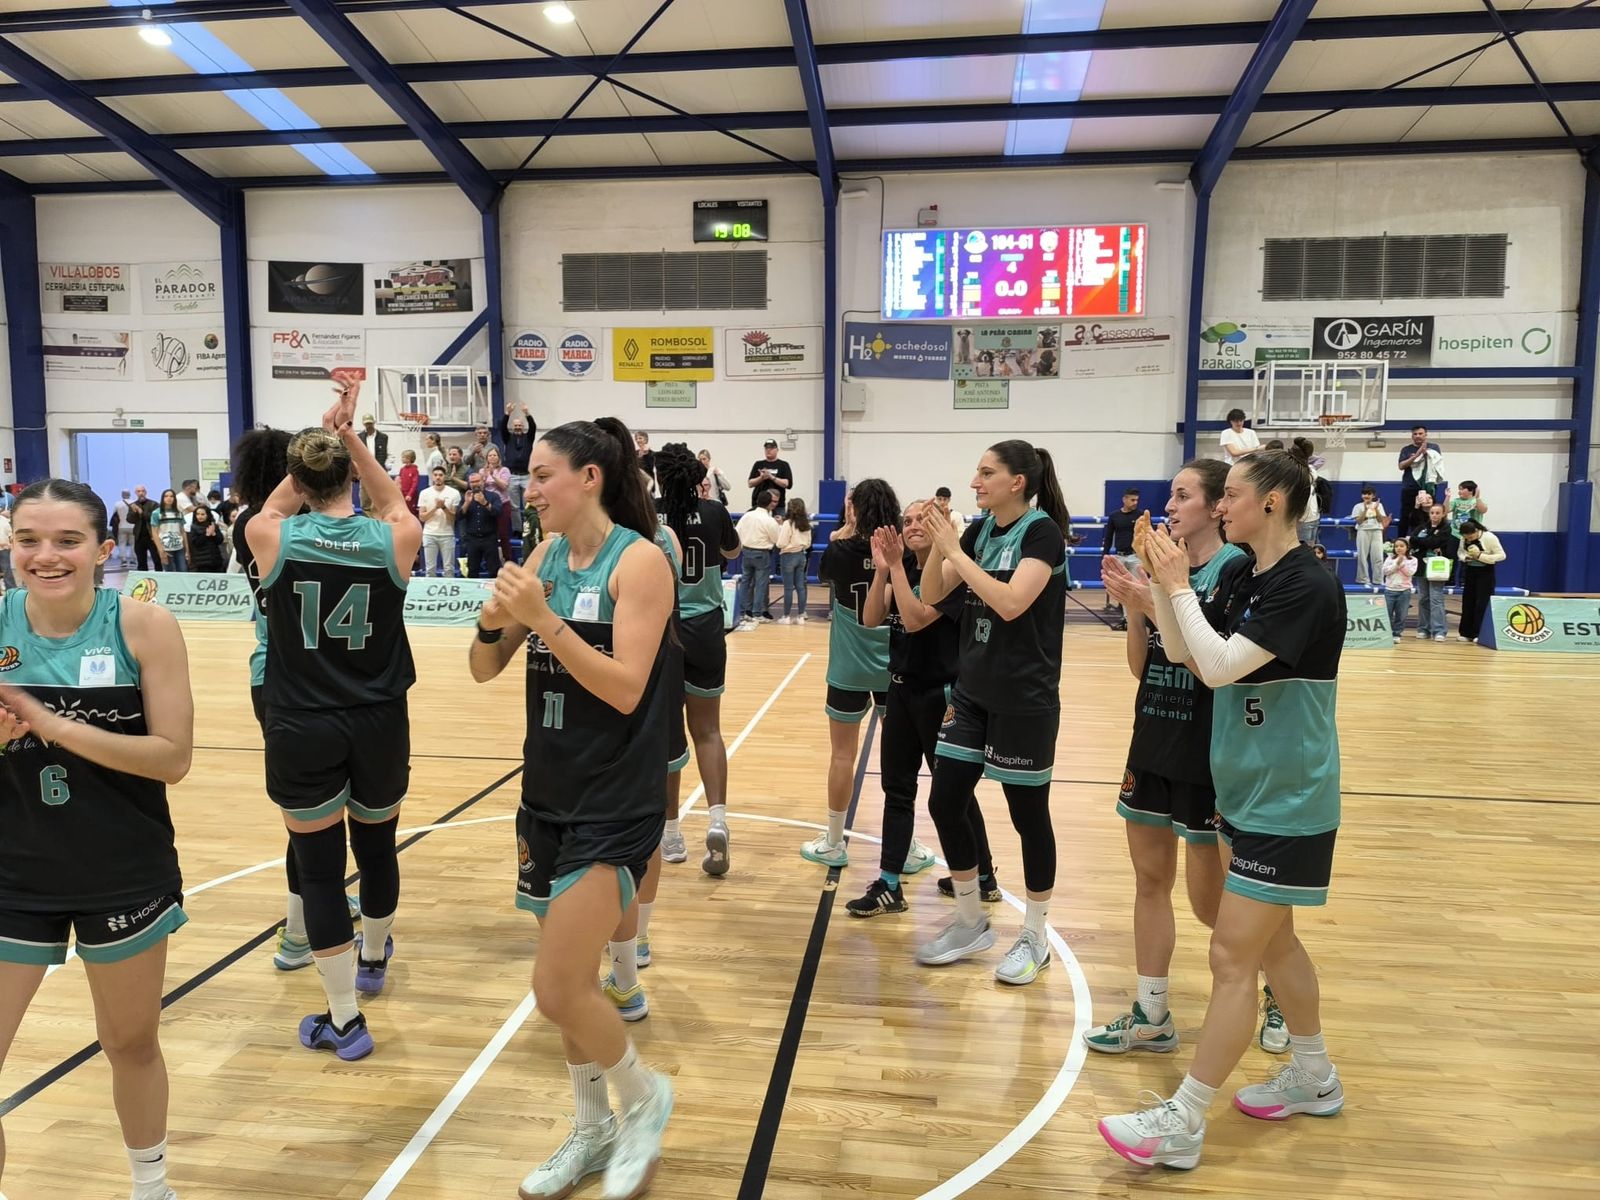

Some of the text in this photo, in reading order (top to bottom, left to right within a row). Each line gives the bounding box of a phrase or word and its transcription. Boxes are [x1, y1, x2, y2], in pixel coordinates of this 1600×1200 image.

[50, 265, 120, 279] VILLALOBOS
[88, 283, 125, 292] ESTEPONA
[155, 282, 216, 295] PARADOR
[1363, 318, 1423, 337] GARÍN
[517, 339, 544, 347] RADIO
[564, 340, 590, 348] RADIO
[650, 337, 708, 347] ROMBOSOL
[1363, 337, 1422, 348] Ingenieros
[1438, 335, 1513, 352] hospiten
[515, 348, 546, 359] MARCA
[562, 349, 593, 360] MARCA
[1337, 350, 1407, 360] 952 80 45 72
[313, 537, 361, 552] SOLER
[196, 579, 229, 591] CAB
[427, 585, 460, 597] CAB
[165, 593, 251, 606] ESTEPONA
[404, 599, 484, 612] STEPONA
[292, 581, 373, 650] 14
[975, 618, 992, 643] 13
[1505, 628, 1552, 643] ESTEPONA
[84, 646, 112, 656] vive
[542, 691, 565, 729] 11
[1244, 696, 1265, 727] 5
[993, 753, 1033, 767] Hospiten
[39, 764, 70, 806] 6
[1232, 854, 1277, 876] ospiten
